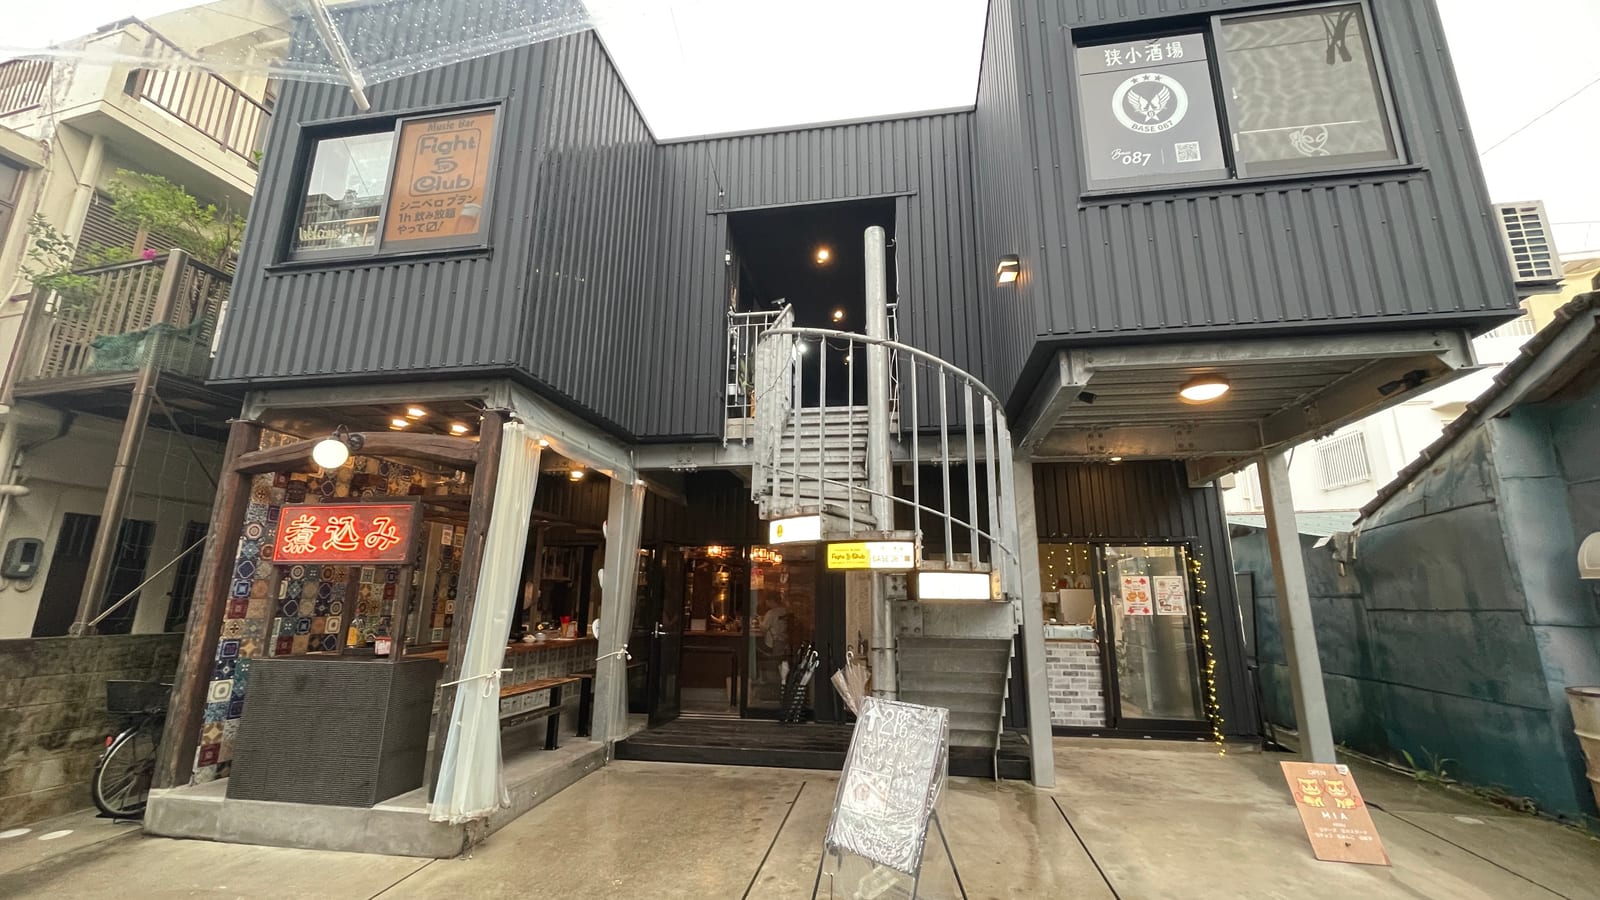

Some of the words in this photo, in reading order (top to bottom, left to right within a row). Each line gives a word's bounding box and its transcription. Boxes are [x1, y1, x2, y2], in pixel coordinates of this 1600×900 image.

[1104, 41, 1184, 66] 狭小酒場
[427, 121, 454, 132] Music
[459, 120, 475, 128] Bar
[1131, 124, 1156, 132] BASE
[420, 135, 477, 155] Fight
[1122, 151, 1152, 167] 087
[413, 174, 471, 192] Club
[282, 514, 400, 554] 煮込み
